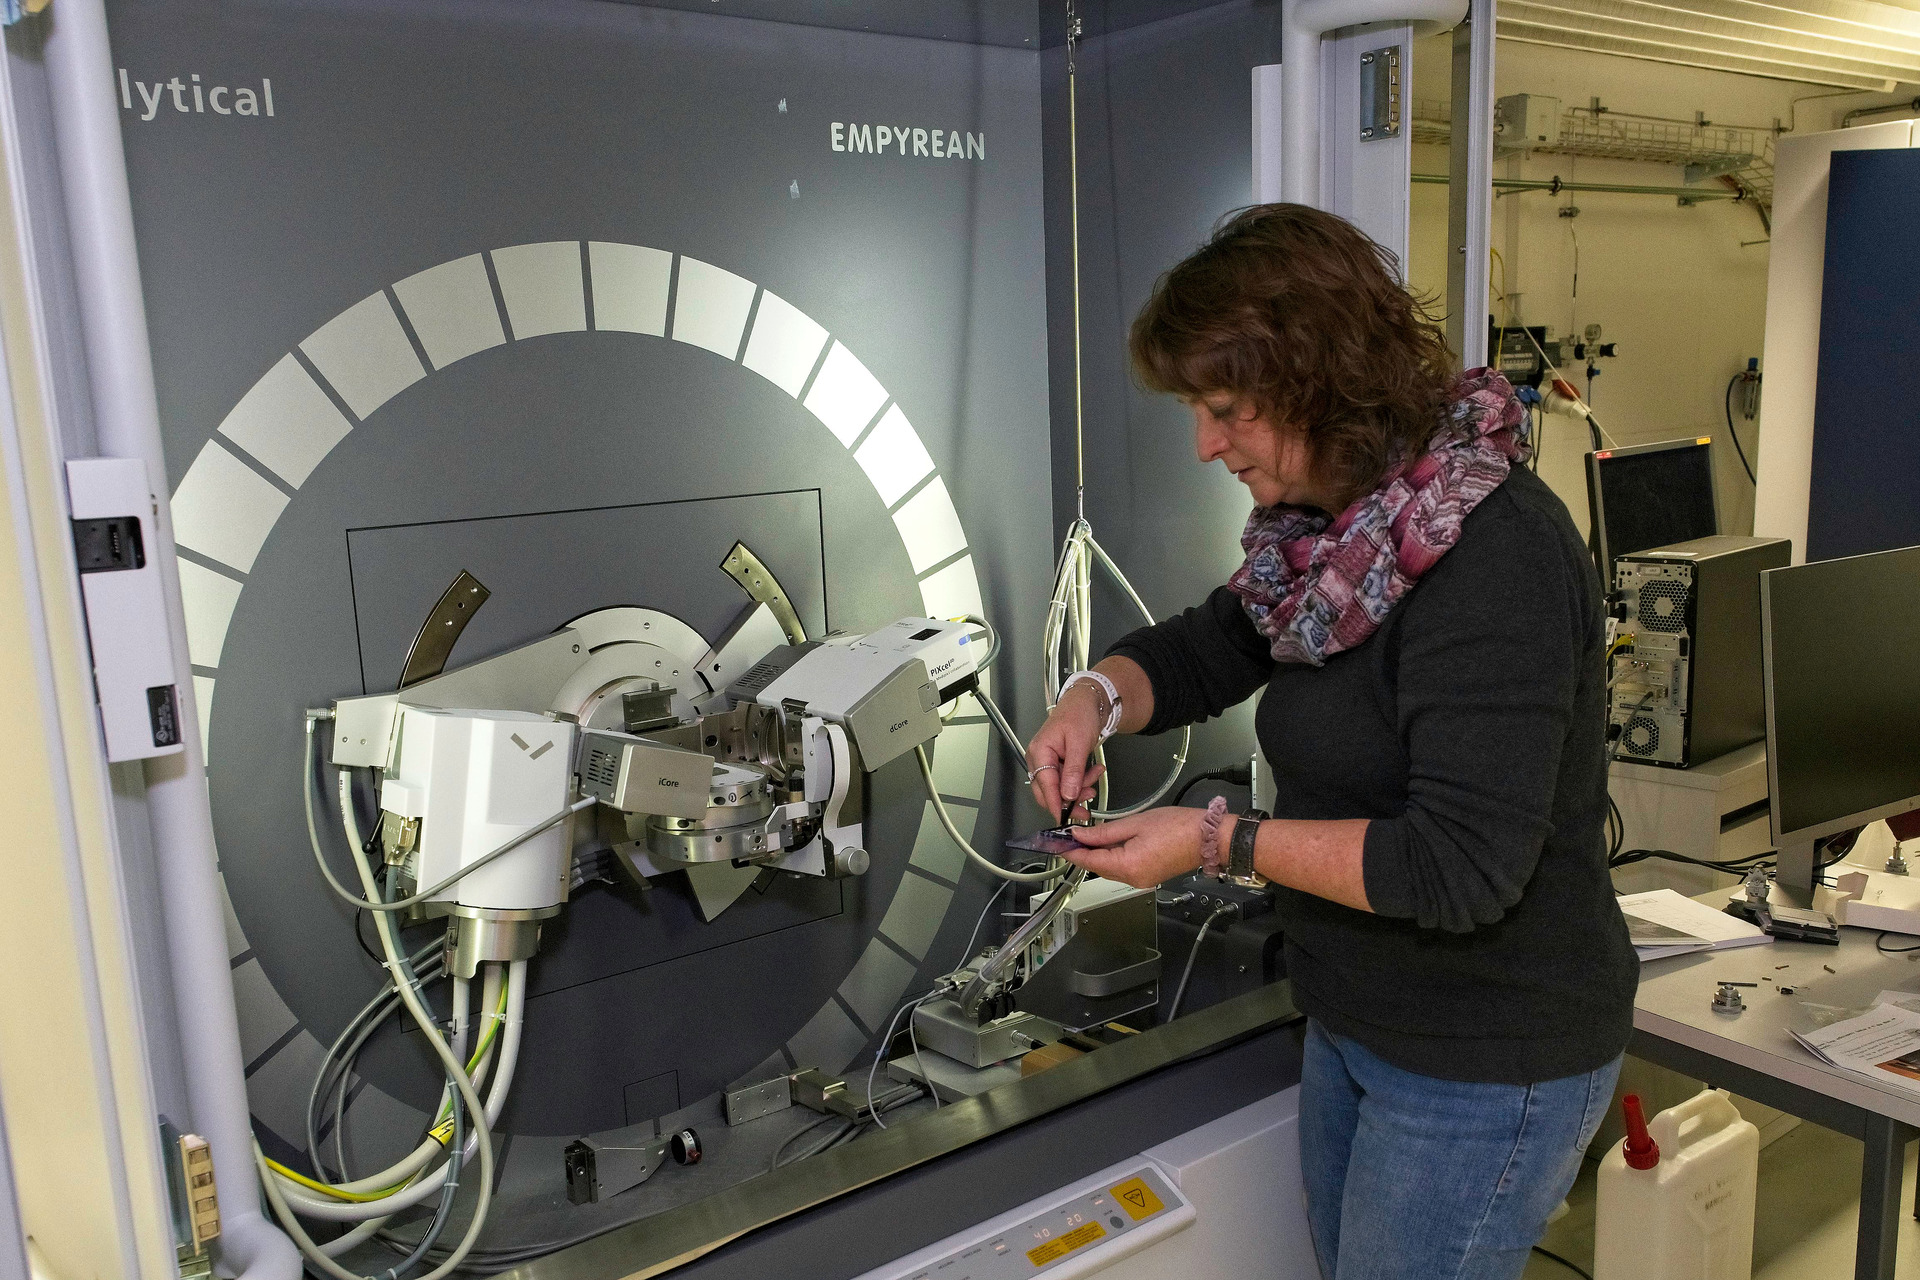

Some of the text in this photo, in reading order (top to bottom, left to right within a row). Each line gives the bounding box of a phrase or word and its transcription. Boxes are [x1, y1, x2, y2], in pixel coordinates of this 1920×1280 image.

[118, 68, 275, 121] lytical
[830, 121, 985, 161] EMPYREAN
[889, 719, 908, 733] dCore
[658, 777, 679, 787] iCore
[1066, 1213, 1082, 1226] 20
